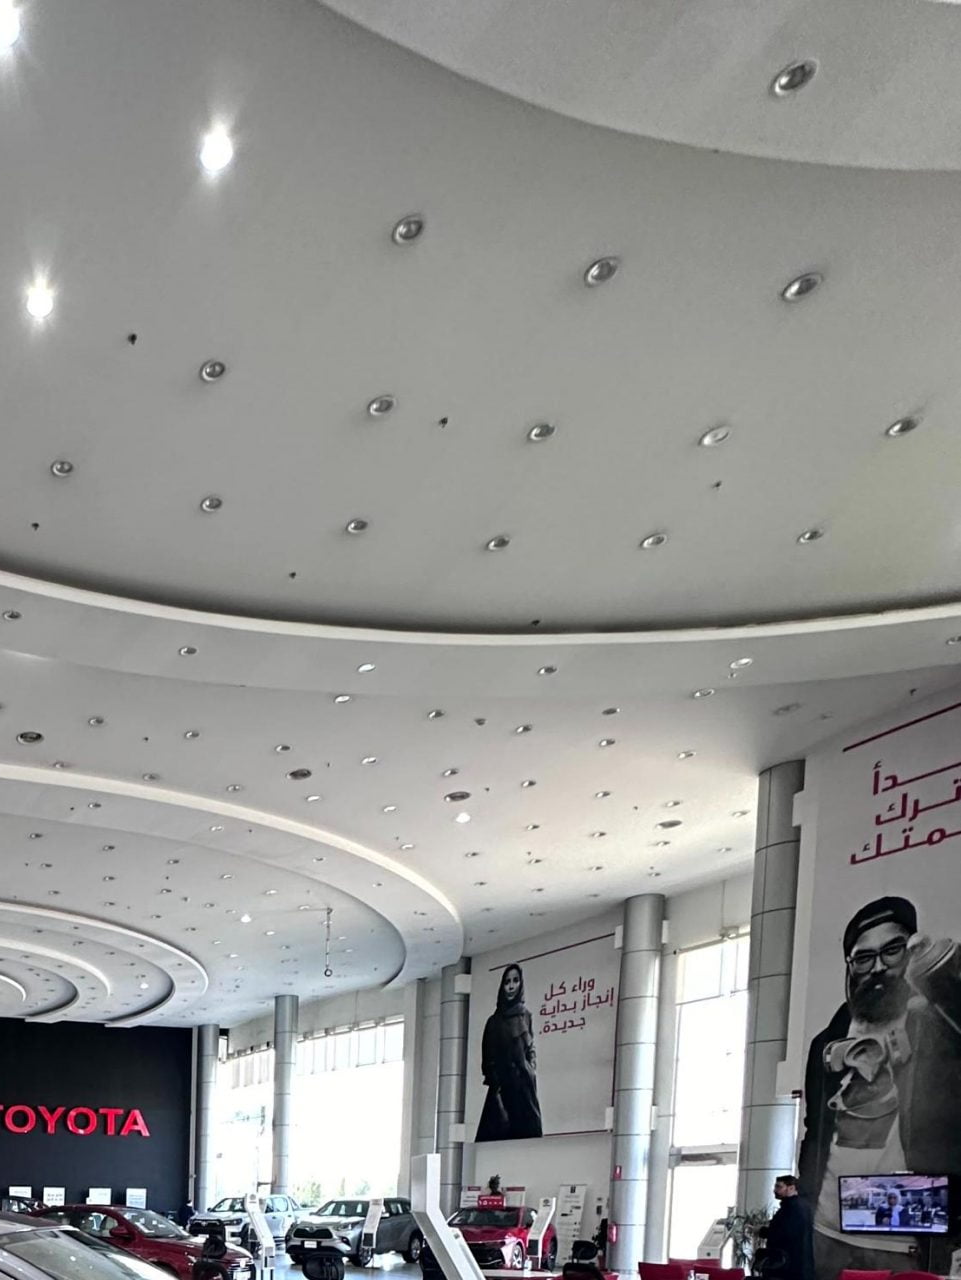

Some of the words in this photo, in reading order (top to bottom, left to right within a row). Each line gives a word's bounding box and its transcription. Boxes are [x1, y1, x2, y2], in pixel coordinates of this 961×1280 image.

[850, 826, 961, 865] متك
[544, 981, 566, 1001] كل
[571, 976, 596, 993] وراء
[581, 986, 614, 1011] إنجاز
[539, 1000, 577, 1018] بداية
